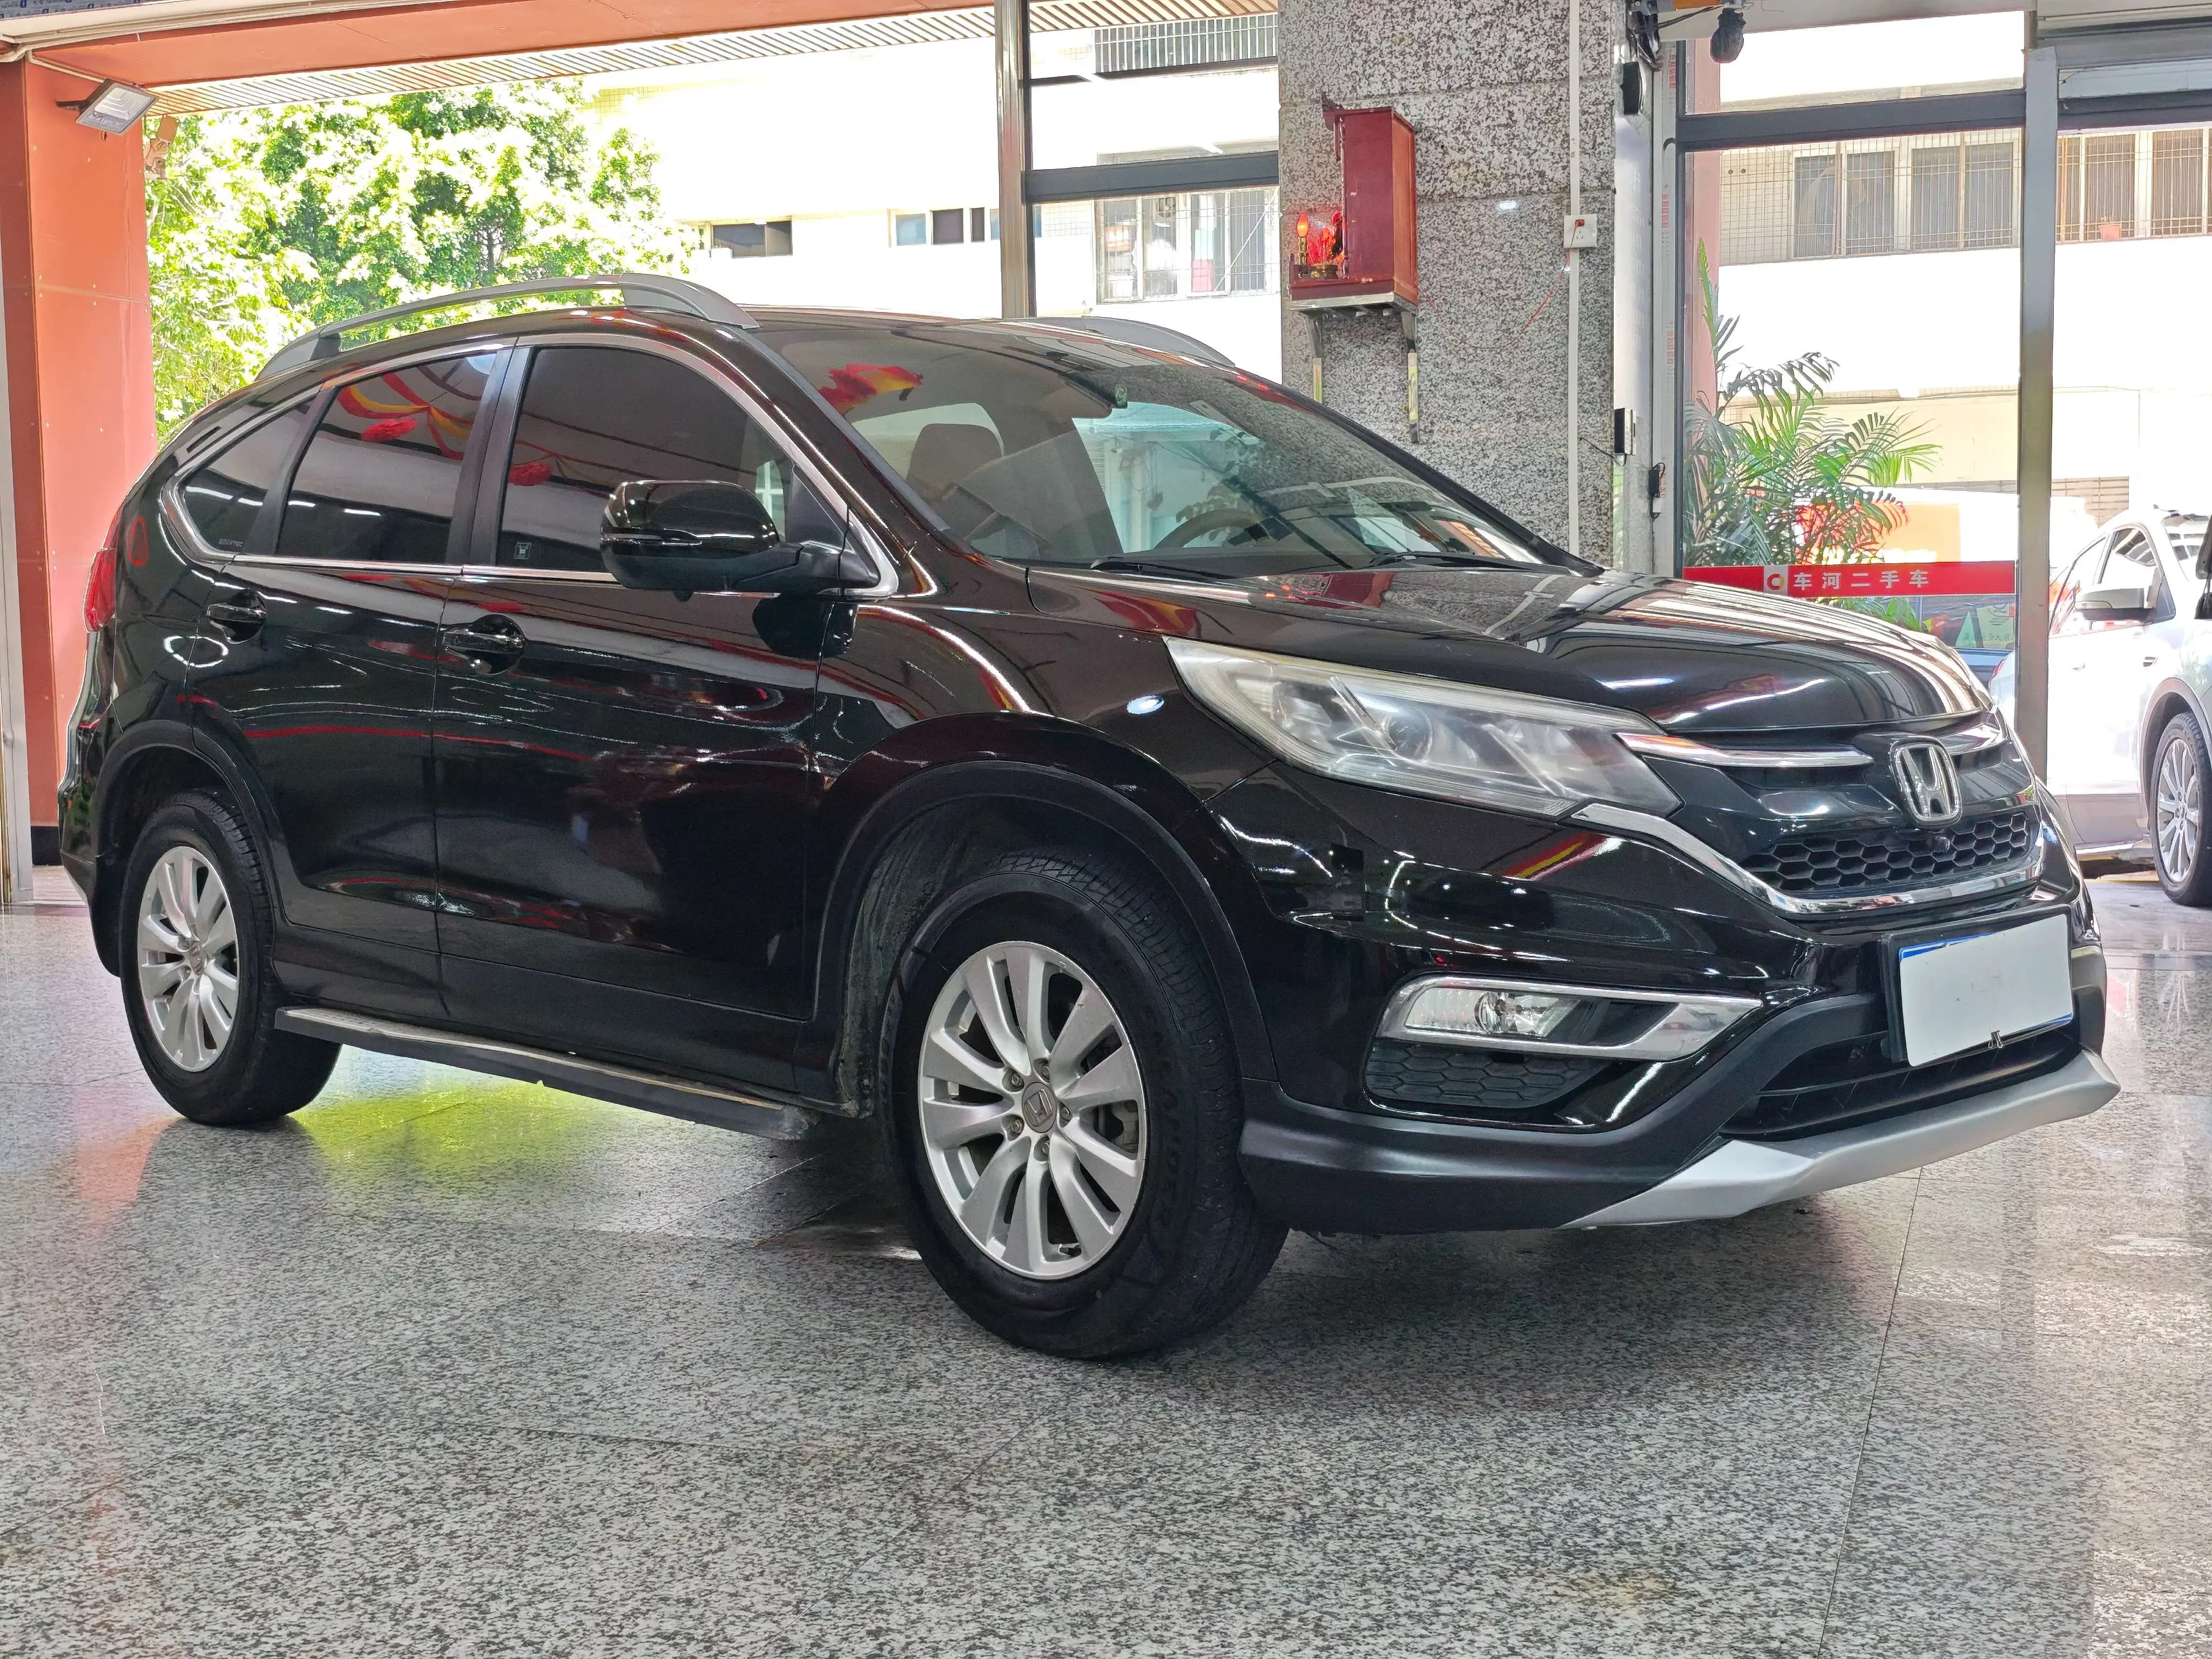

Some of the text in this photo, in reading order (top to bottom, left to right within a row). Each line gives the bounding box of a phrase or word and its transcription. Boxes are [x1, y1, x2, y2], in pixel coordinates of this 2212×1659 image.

[1793, 569, 1928, 591] 车河二手车
